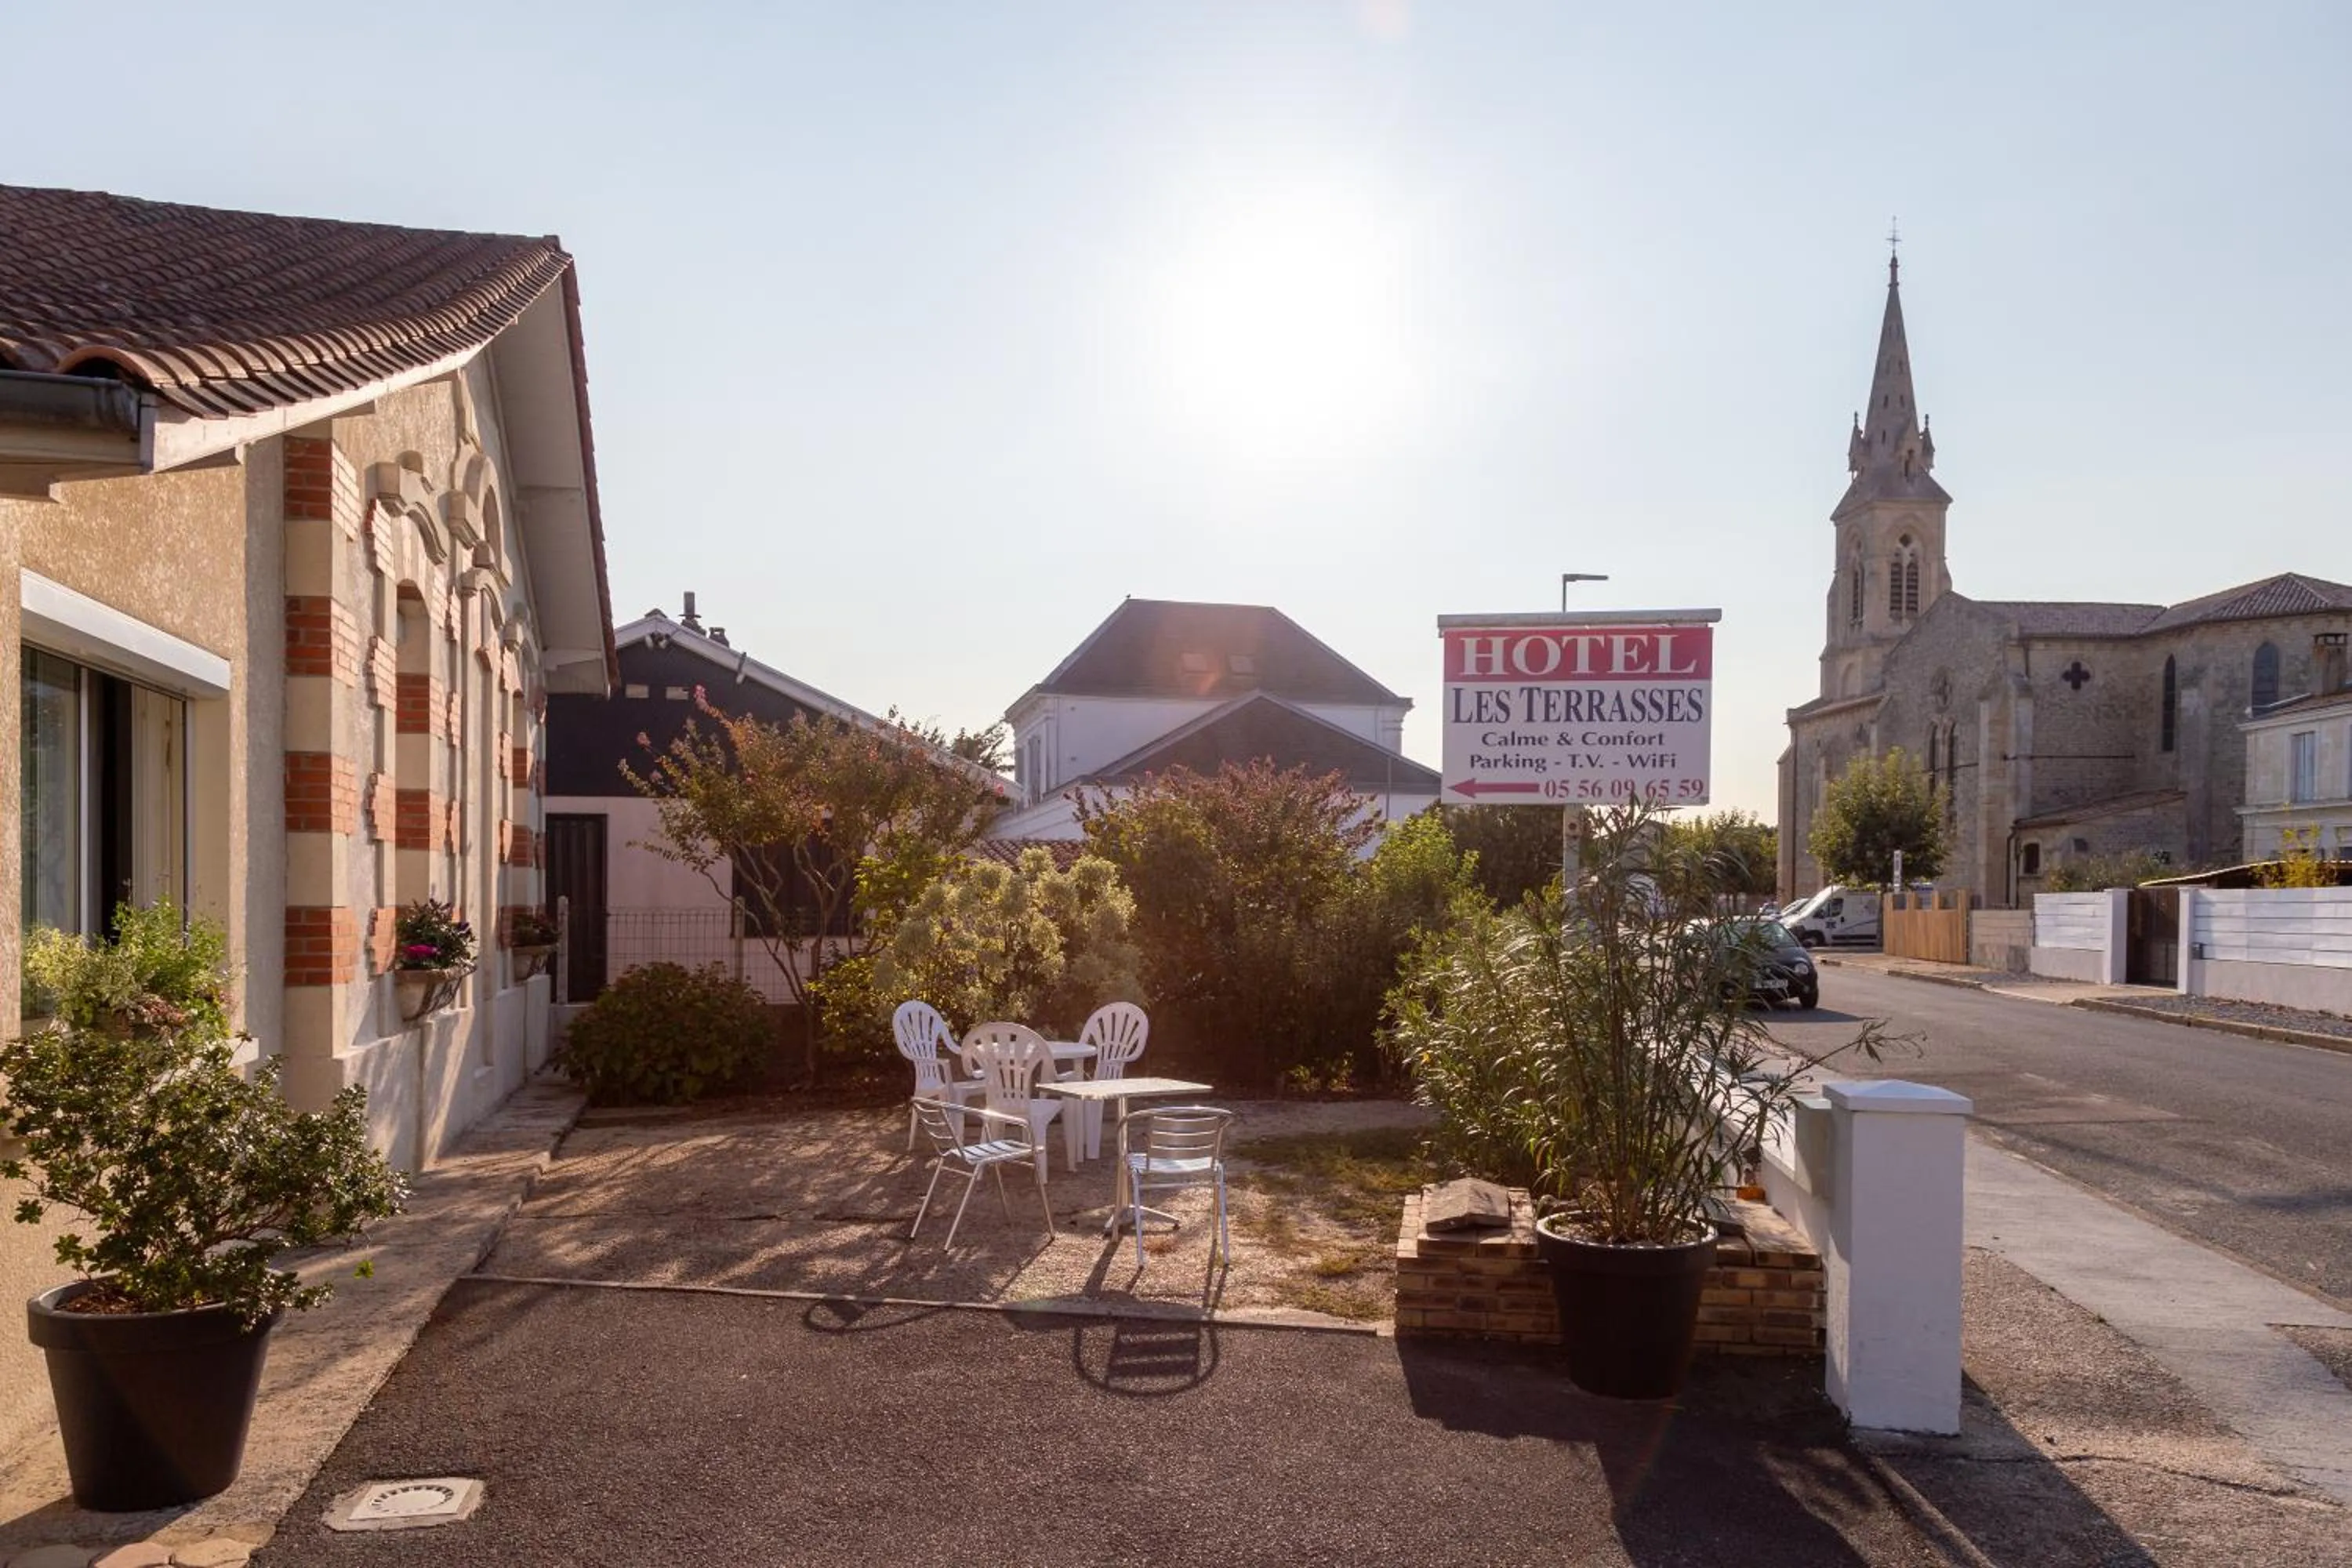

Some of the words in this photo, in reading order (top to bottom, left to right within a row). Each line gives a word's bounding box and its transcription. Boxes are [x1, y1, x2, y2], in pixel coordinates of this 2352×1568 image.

[1460, 633, 1697, 675] HOTEL
[1452, 688, 1511, 724] LES
[1519, 686, 1703, 724] TERRASSES
[1481, 731, 1548, 747] Calme
[1557, 731, 1573, 746] &
[1581, 731, 1665, 747] Confort
[1470, 753, 1548, 774] Parking
[1569, 753, 1604, 768] T.V.
[1627, 753, 1676, 769] WiFi
[1544, 779, 1570, 799] 05
[1577, 779, 1603, 798] 56
[1610, 779, 1636, 798] 09
[1646, 779, 1670, 798] 65
[1678, 779, 1704, 798] 59
